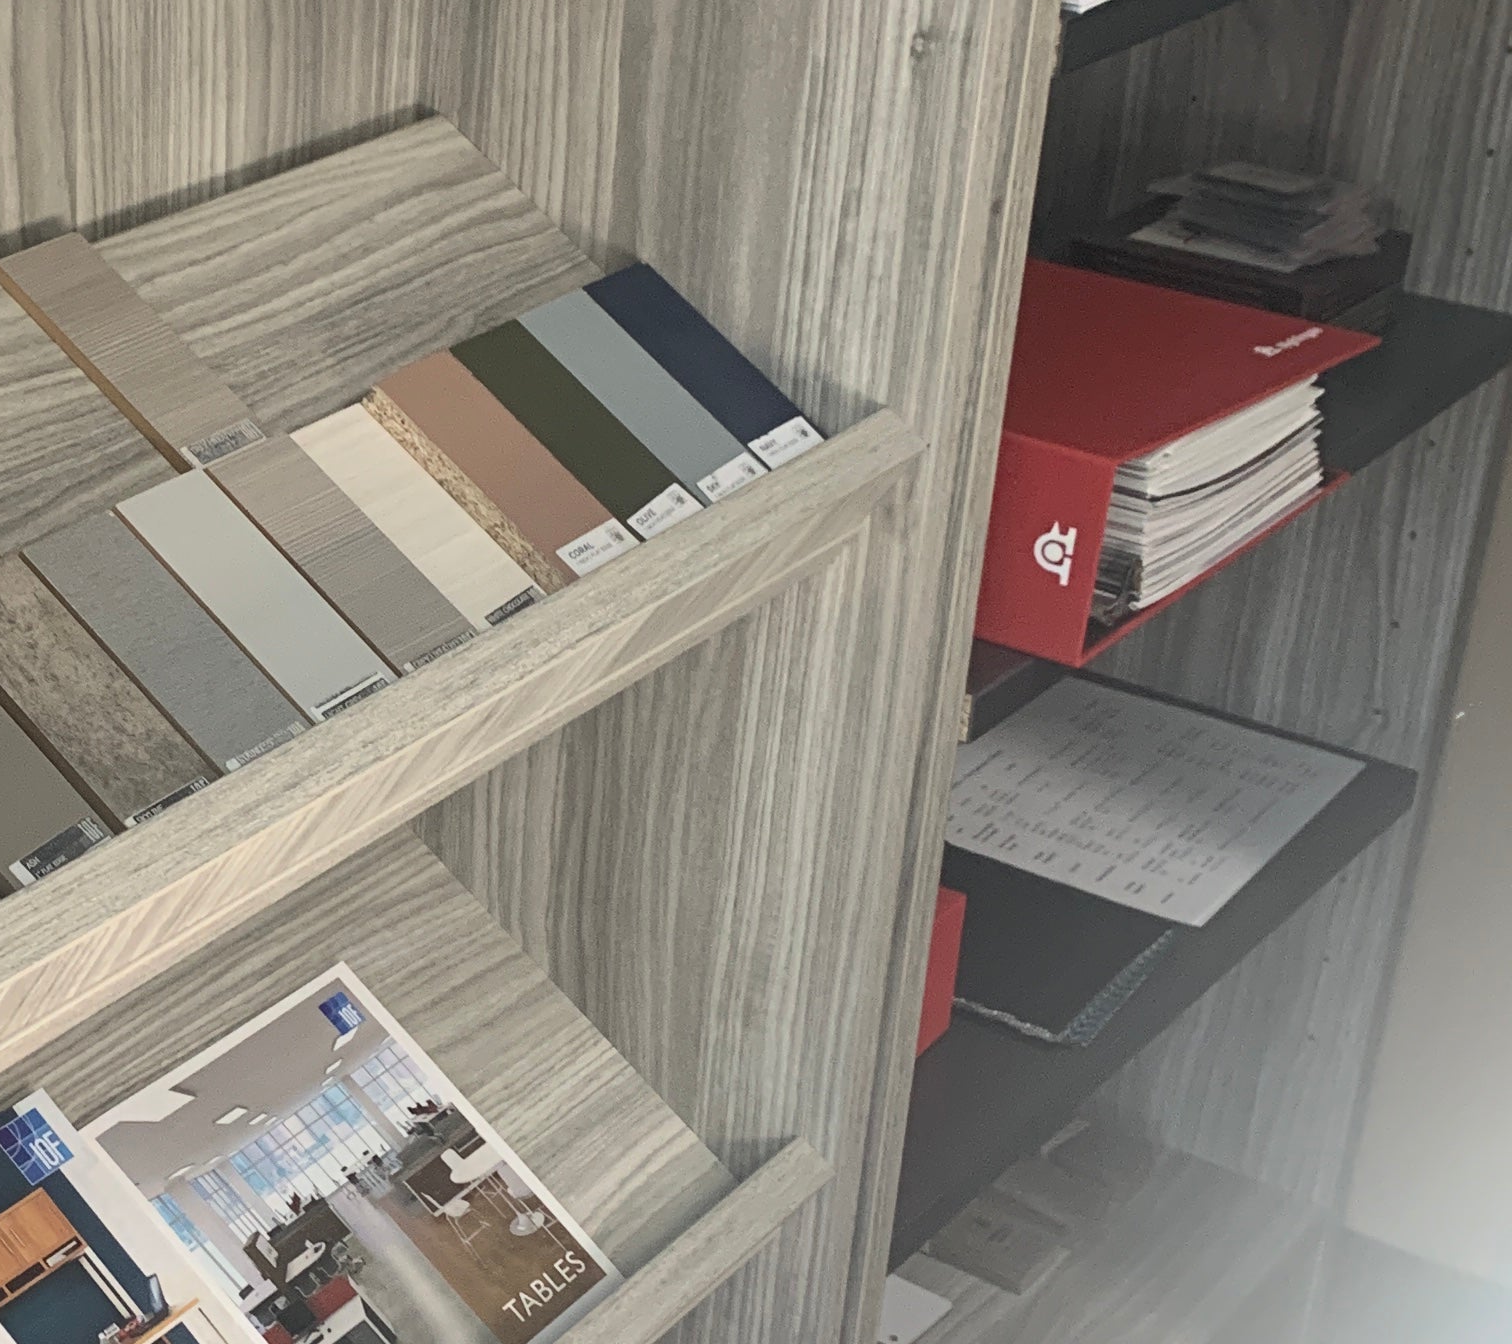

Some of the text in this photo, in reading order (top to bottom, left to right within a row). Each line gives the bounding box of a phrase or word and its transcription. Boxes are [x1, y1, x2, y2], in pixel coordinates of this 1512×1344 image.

[636, 508, 657, 526] OLIVE
[568, 541, 595, 559] CORAL
[77, 816, 104, 843] IOF
[28, 1129, 65, 1170] IOF
[501, 1250, 586, 1323] TABLES
